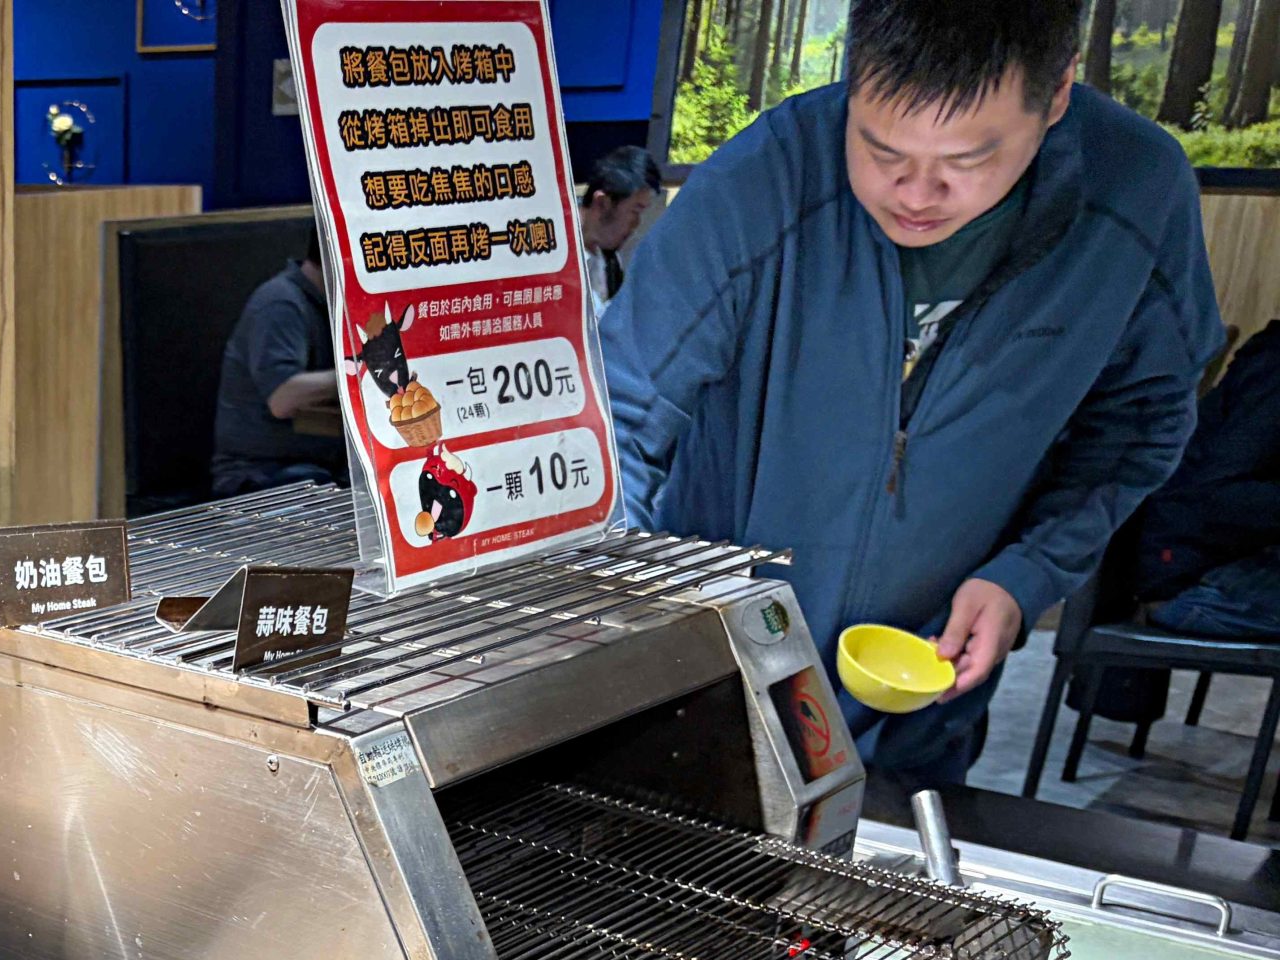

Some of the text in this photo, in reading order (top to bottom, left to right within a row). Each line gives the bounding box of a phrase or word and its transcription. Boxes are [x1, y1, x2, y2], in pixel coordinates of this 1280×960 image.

[340, 45, 516, 88] 將餐包放入烤箱中
[338, 103, 535, 151] 從烤箱掉出即可食用
[361, 161, 536, 211] 想要吃焦焦的口感
[15, 554, 108, 590] 奶油餐包
[31, 597, 97, 614] My Home Steak
[256, 604, 328, 637] 蒜味餐包
